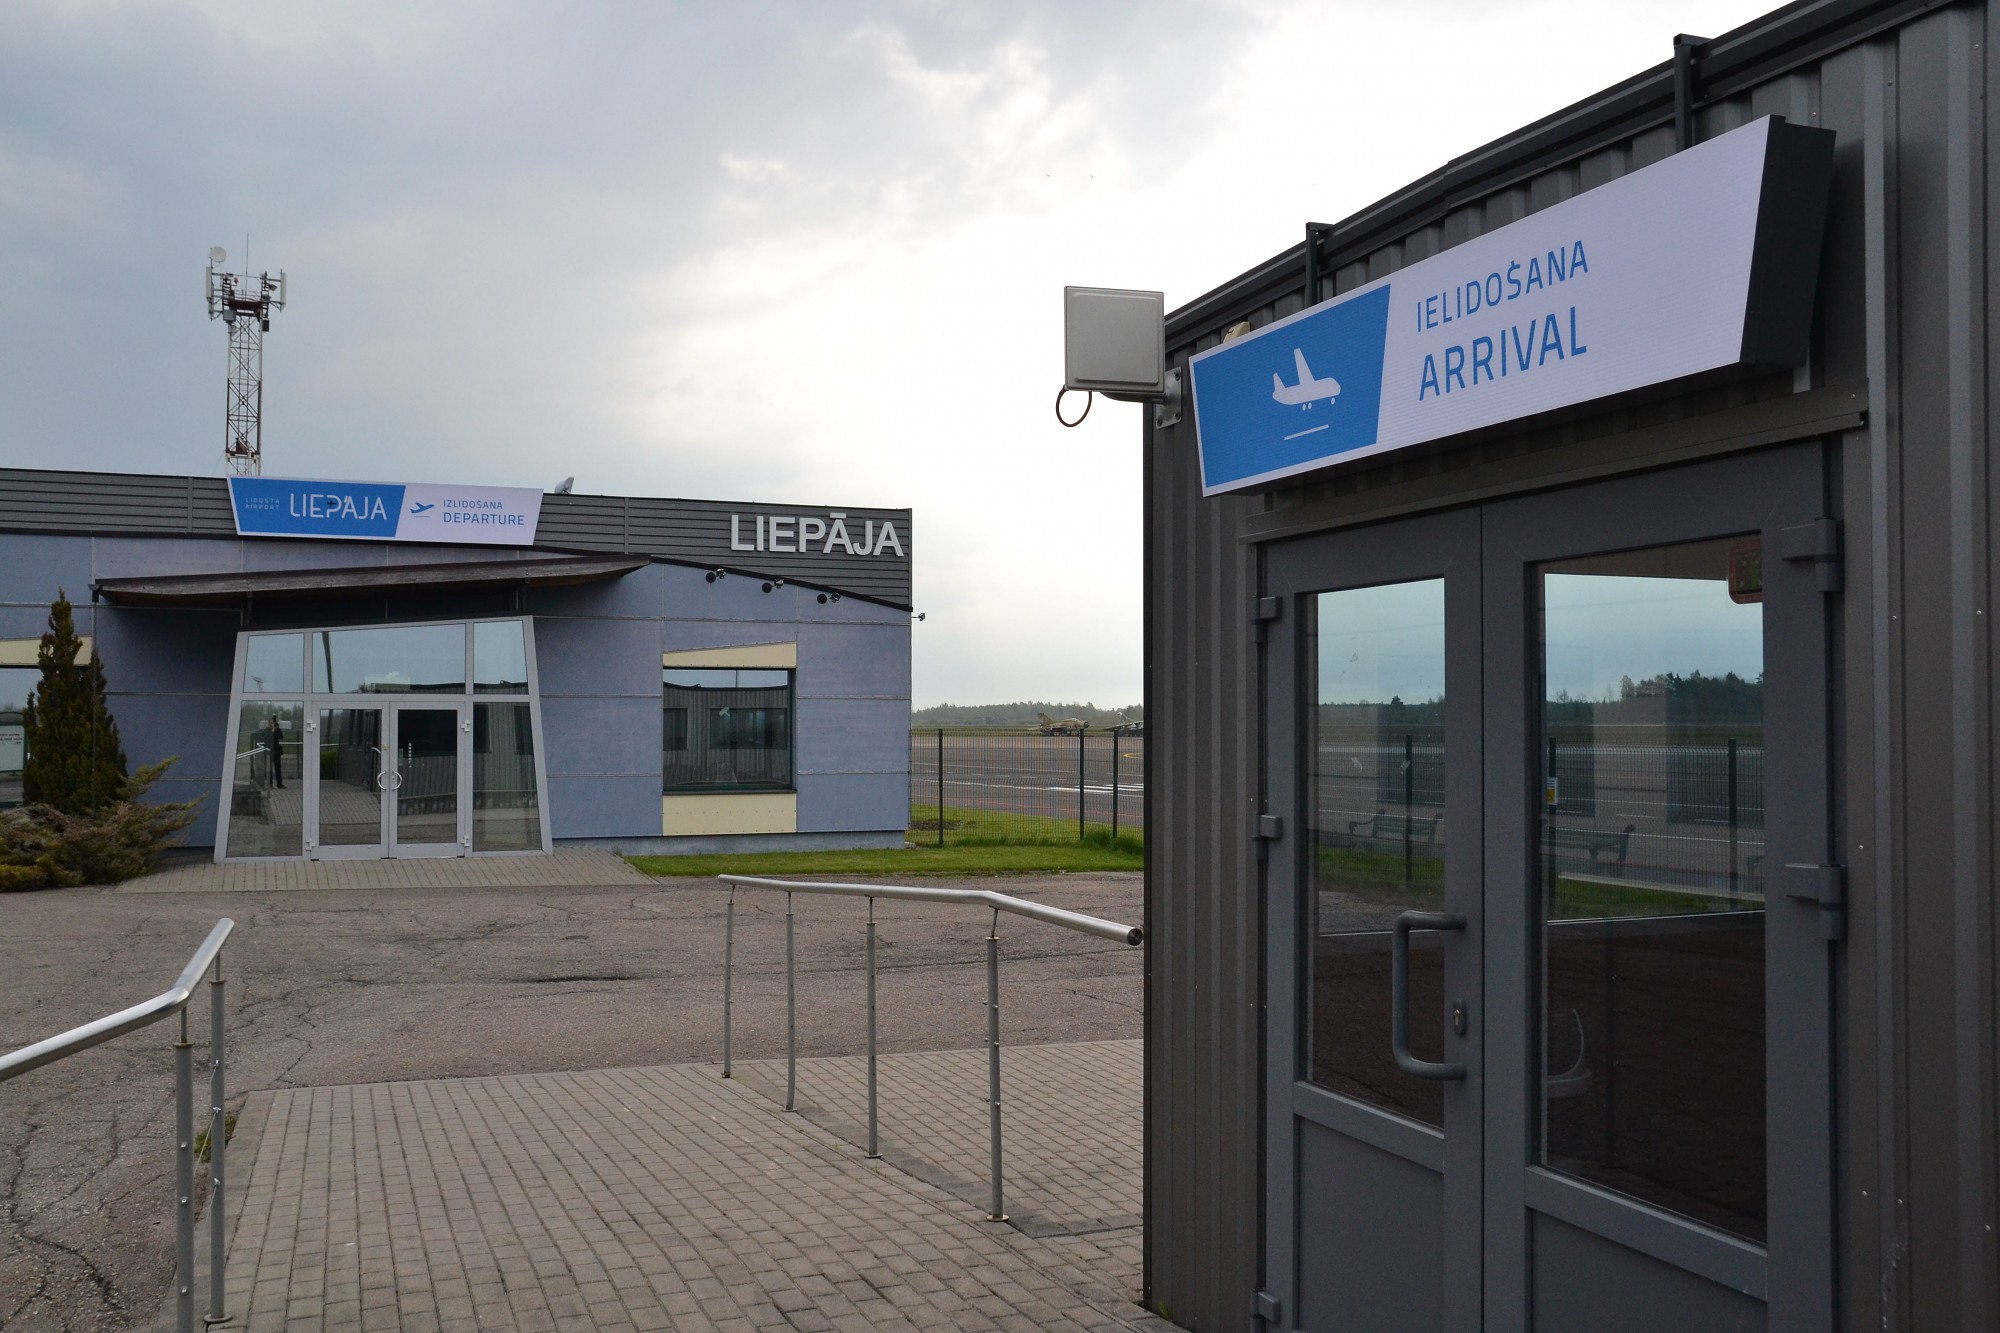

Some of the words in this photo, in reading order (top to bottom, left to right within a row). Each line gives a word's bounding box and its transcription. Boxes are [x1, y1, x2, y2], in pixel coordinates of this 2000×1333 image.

[1419, 306, 1588, 401] ARRIVAL
[443, 512, 525, 526] DEPARTURE
[731, 512, 904, 557] LIEPĀJA
